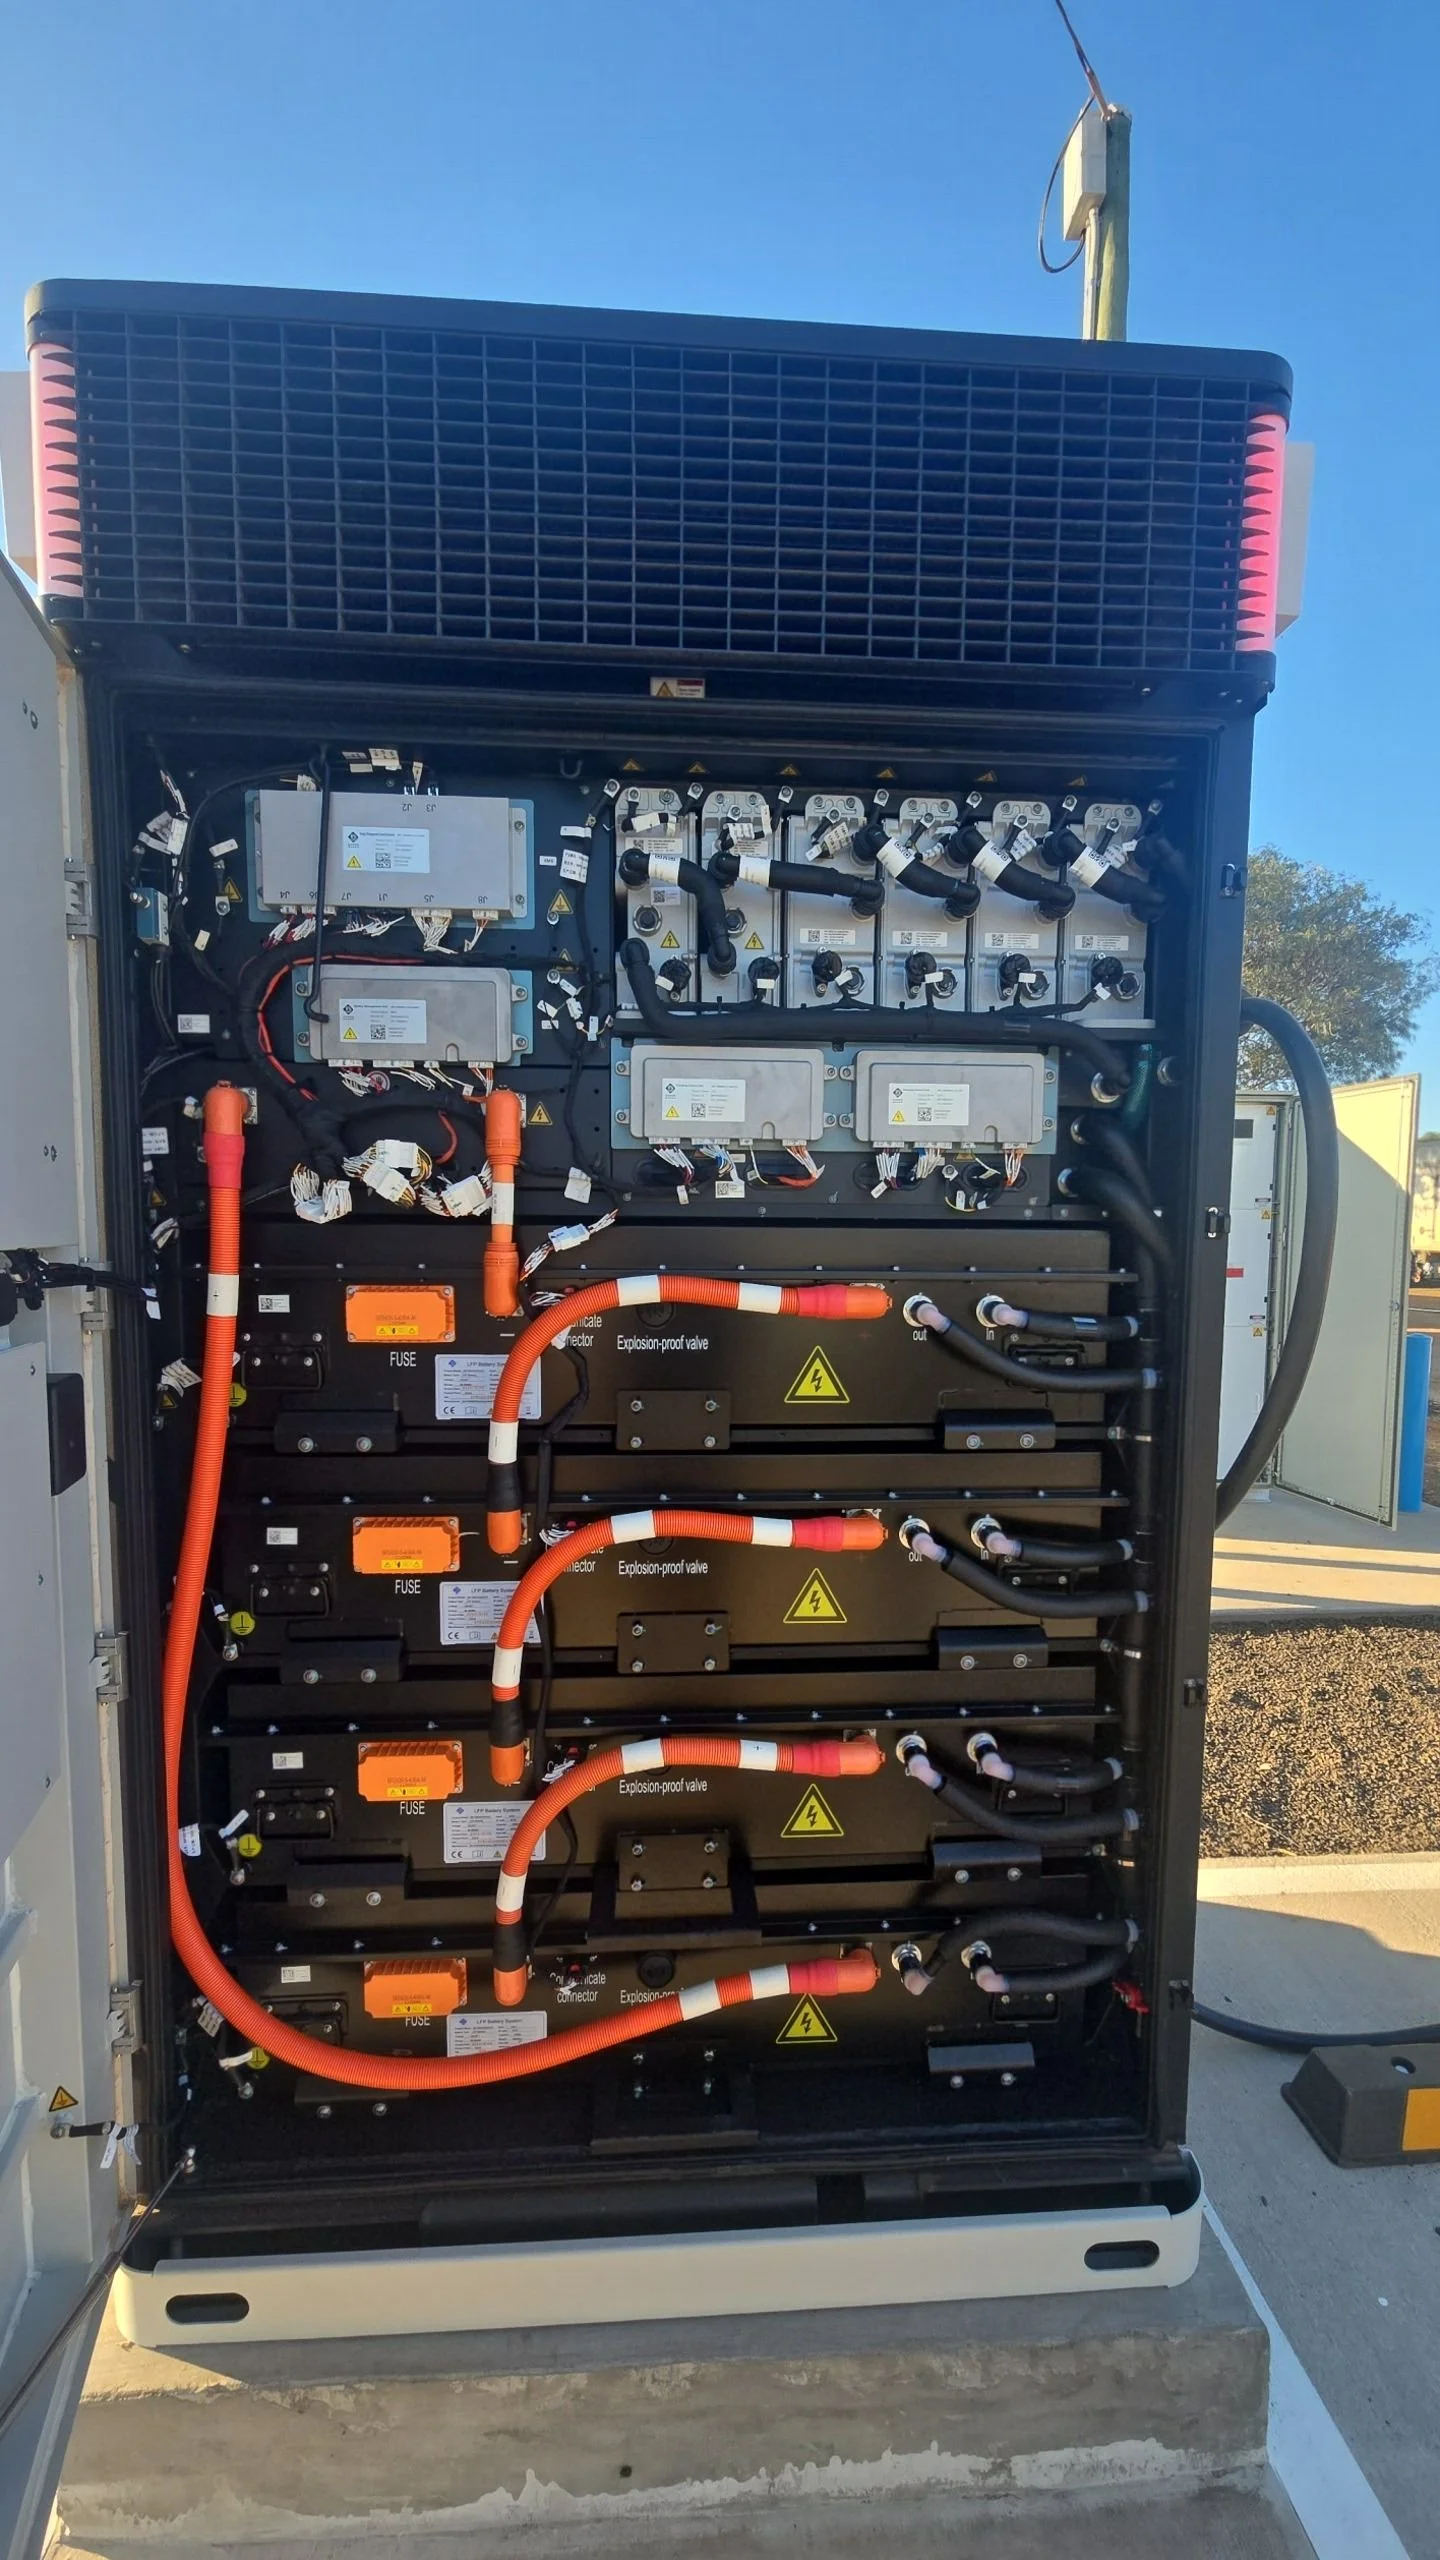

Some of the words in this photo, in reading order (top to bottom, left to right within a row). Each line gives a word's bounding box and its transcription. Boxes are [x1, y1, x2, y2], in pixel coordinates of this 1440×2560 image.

[912, 1328, 927, 1341] out
[617, 1335, 684, 1353] Explosion-proof
[686, 1335, 708, 1350] valve
[390, 1352, 416, 1367] FUSE
[618, 1560, 685, 1578] Explosion-proof
[686, 1559, 708, 1574] valve
[395, 1579, 421, 1594] FUSE
[619, 1778, 685, 1796] Explosion-proof
[687, 1777, 708, 1792] valve
[400, 1801, 425, 1815] FUSE
[405, 2015, 430, 2028] FUSE
